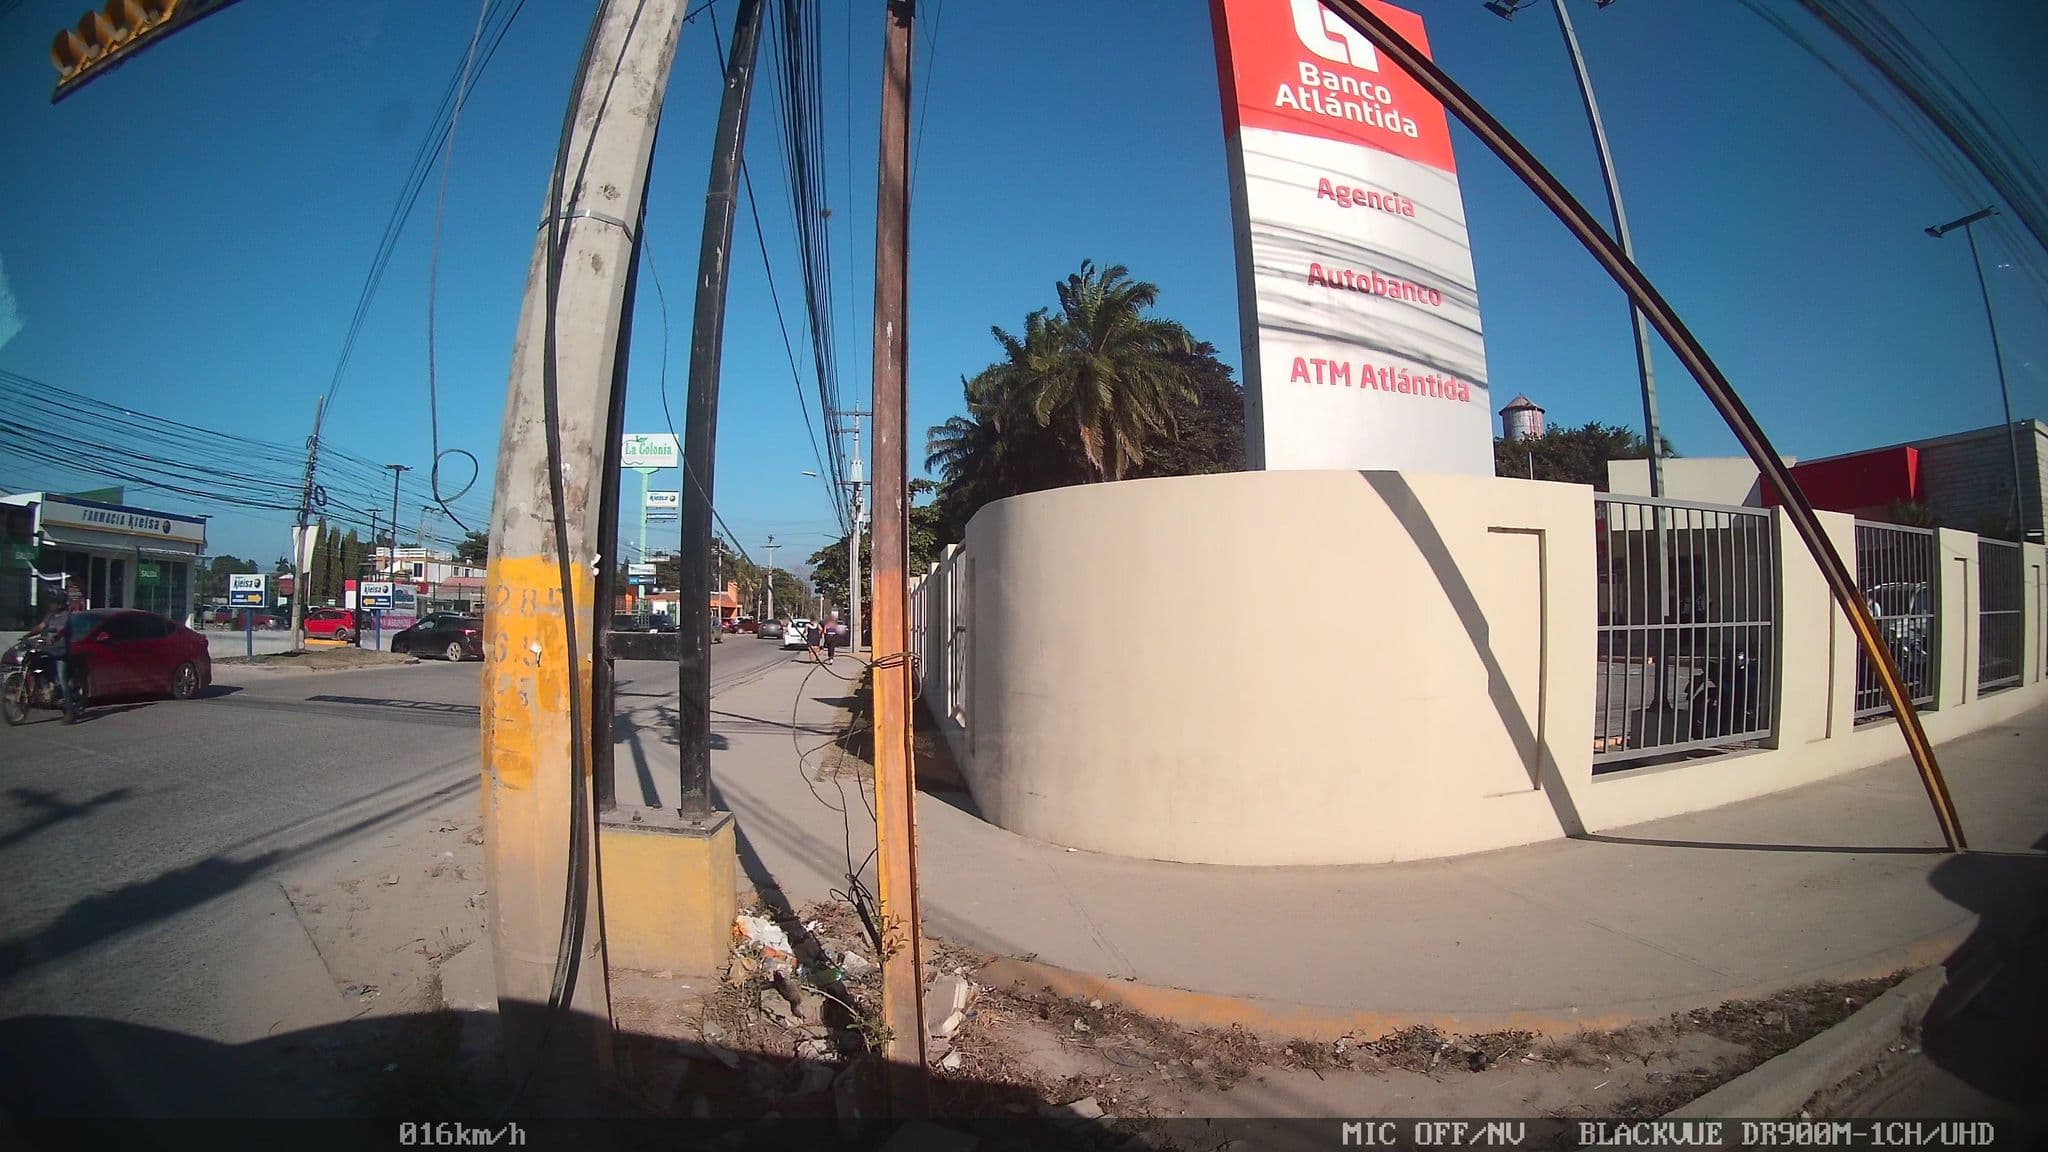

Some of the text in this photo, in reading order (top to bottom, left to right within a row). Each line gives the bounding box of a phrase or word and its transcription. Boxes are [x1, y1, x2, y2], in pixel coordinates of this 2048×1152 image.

[1299, 61, 1392, 105] Banco
[1275, 83, 1419, 138] Atlántida
[1317, 177, 1416, 218] Agencia
[1308, 262, 1442, 307] Autobanco
[1290, 356, 1471, 402] ATM Atlántida
[625, 442, 672, 456] La Colonia
[82, 509, 126, 526] FARMACIA
